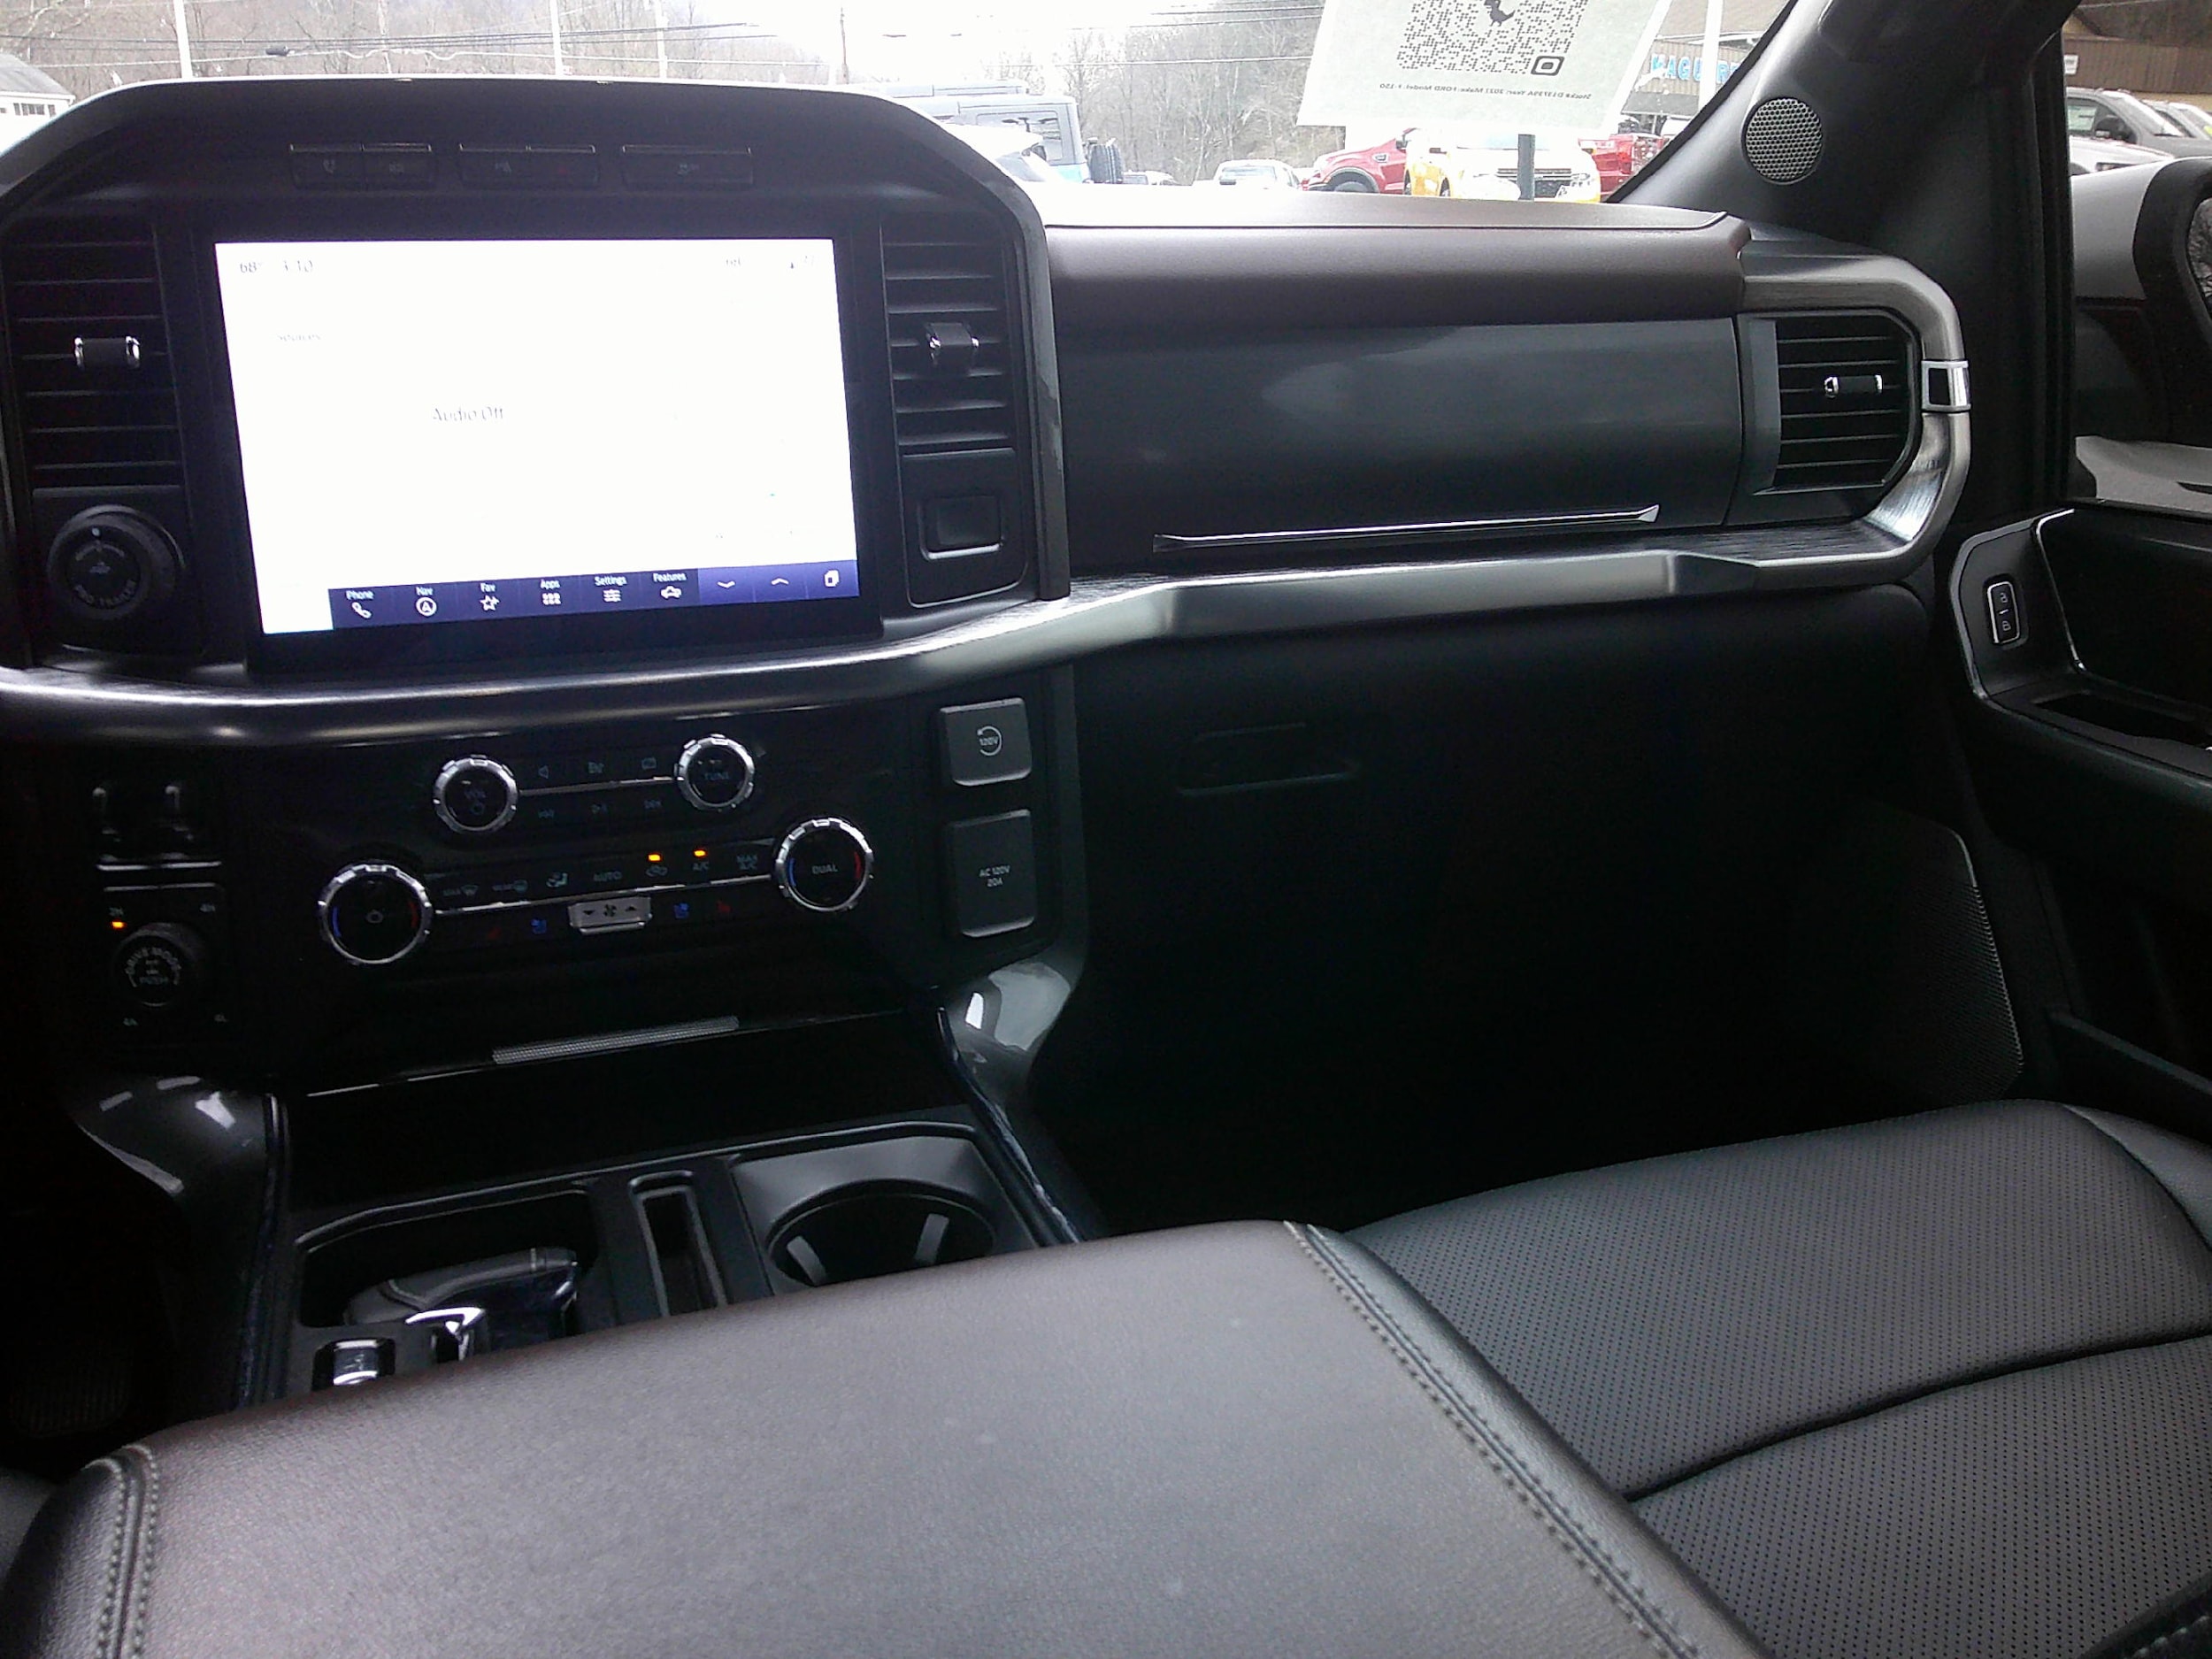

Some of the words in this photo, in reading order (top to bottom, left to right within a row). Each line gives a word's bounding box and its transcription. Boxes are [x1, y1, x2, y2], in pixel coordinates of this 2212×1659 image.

[594, 575, 627, 588] Settings
[653, 572, 687, 583] Features
[480, 583, 495, 593] Fav
[541, 579, 561, 590] Apps
[346, 589, 374, 601] Phone
[416, 587, 434, 597] Nav
[810, 864, 839, 876] DUAL
[979, 867, 991, 878] AC
[592, 870, 623, 883] AUTO
